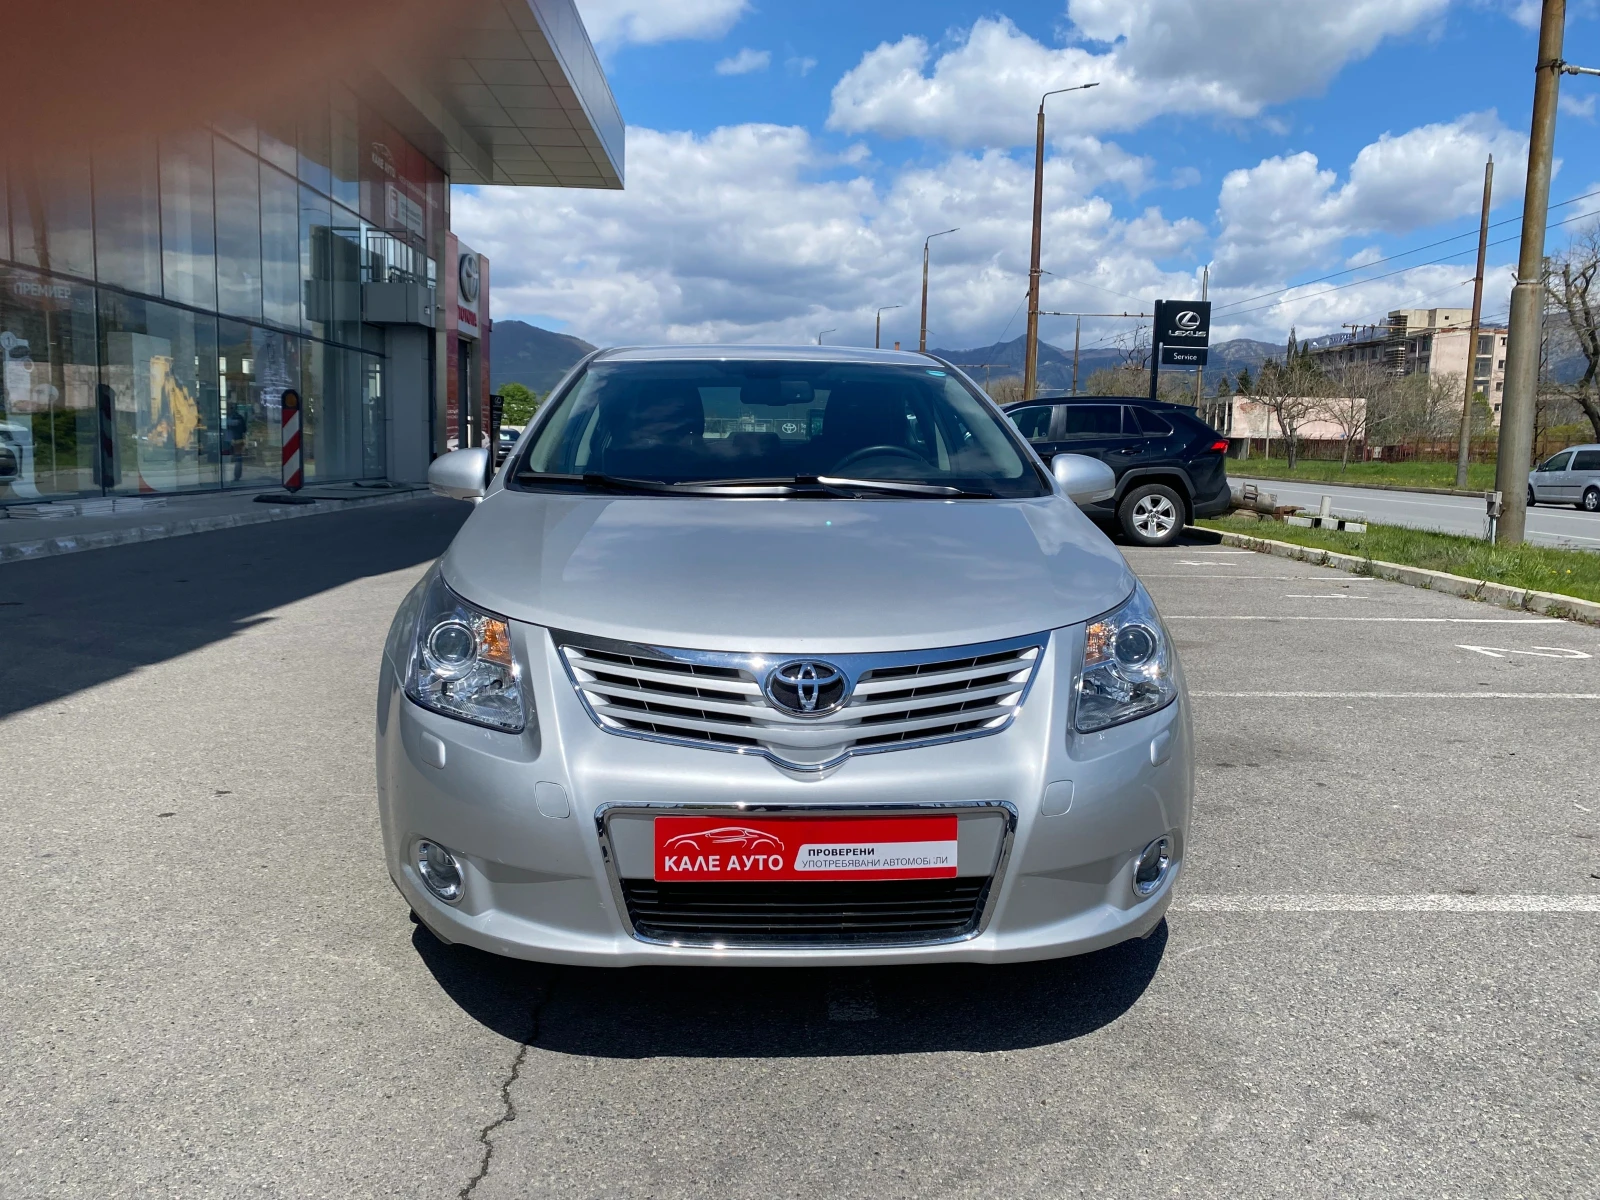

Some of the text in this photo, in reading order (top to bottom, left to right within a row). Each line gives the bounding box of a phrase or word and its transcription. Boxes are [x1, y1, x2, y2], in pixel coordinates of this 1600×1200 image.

[14, 281, 71, 299] ПРЕМИЕР
[1173, 352, 1198, 361] Service
[808, 848, 875, 857] ПРОВЕРЕНИ
[664, 854, 784, 872] КАЛЕ АУТО
[801, 858, 880, 869] УПОТРЕБЯВАНИ
